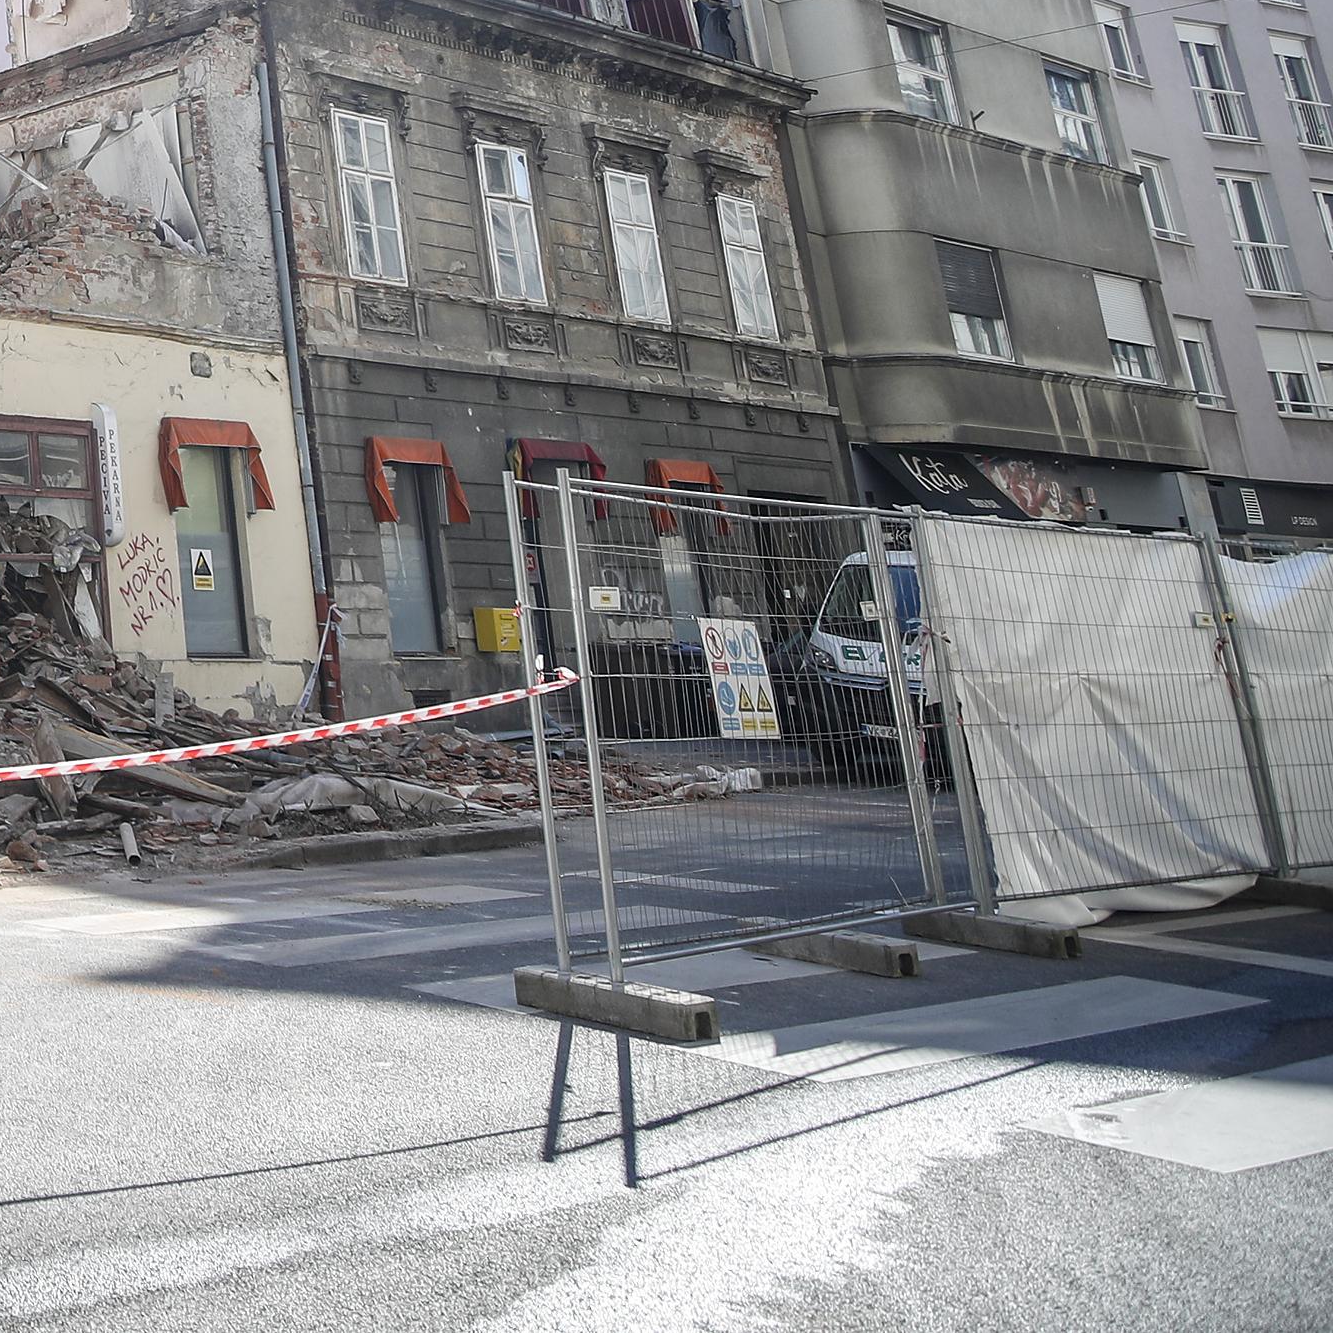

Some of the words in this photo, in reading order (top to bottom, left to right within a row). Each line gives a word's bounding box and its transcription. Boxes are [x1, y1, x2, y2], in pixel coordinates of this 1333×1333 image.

[99, 435, 111, 515] PECIVA
[898, 453, 969, 495] Kata
[117, 533, 155, 571] LUKA
[119, 537, 166, 607] MODRIĆ
